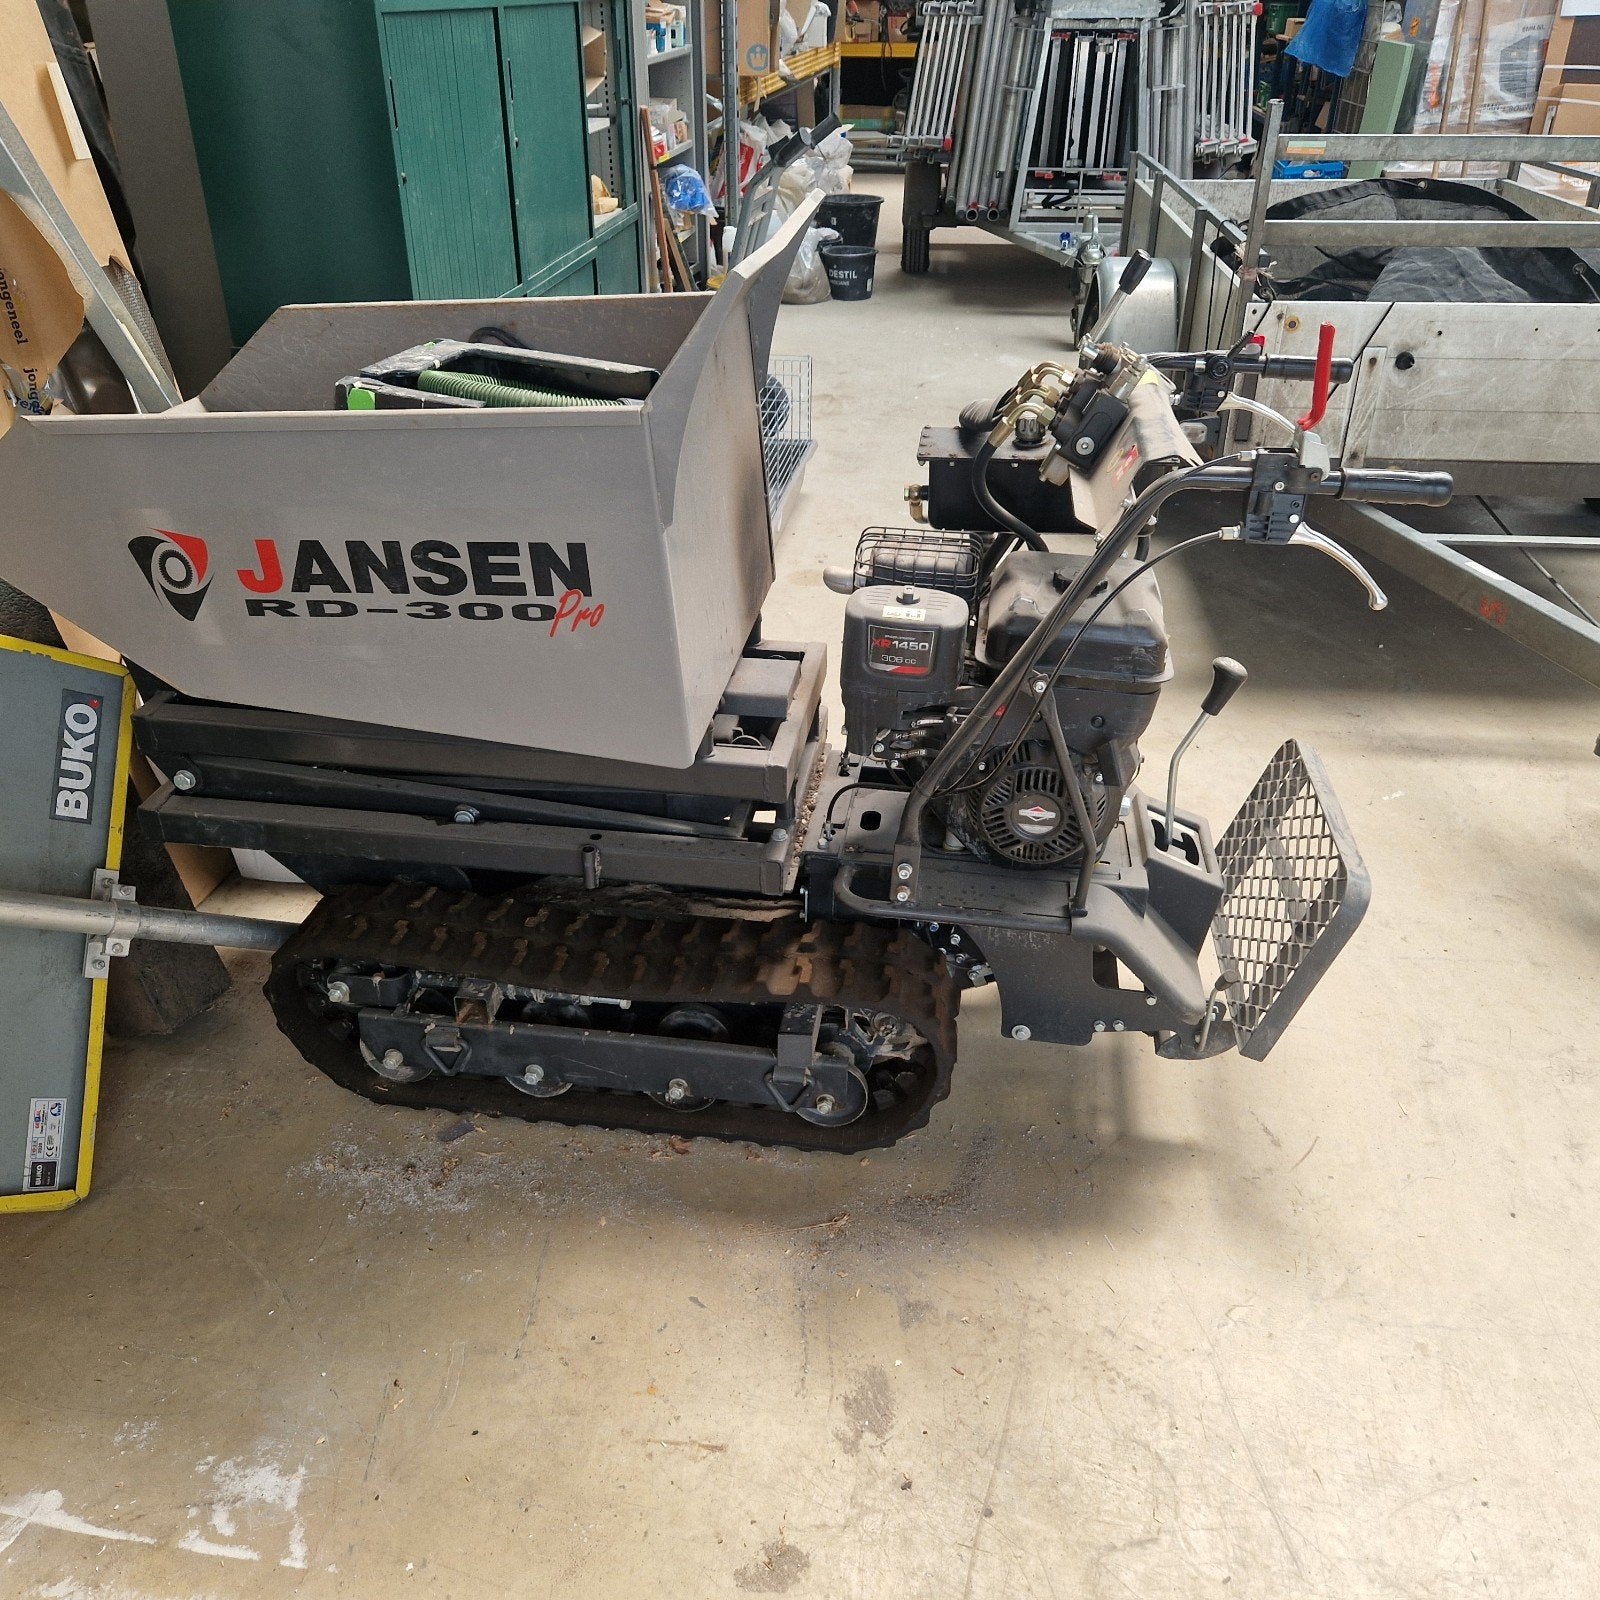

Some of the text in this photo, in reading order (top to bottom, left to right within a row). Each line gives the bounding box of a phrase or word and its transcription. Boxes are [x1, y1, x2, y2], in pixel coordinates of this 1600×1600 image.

[829, 269, 857, 279] DESTIL
[0, 267, 30, 345] ongeneel
[237, 539, 592, 597] JANSEN
[245, 589, 605, 637] RD-300 Pro
[55, 703, 98, 819] BUKO
